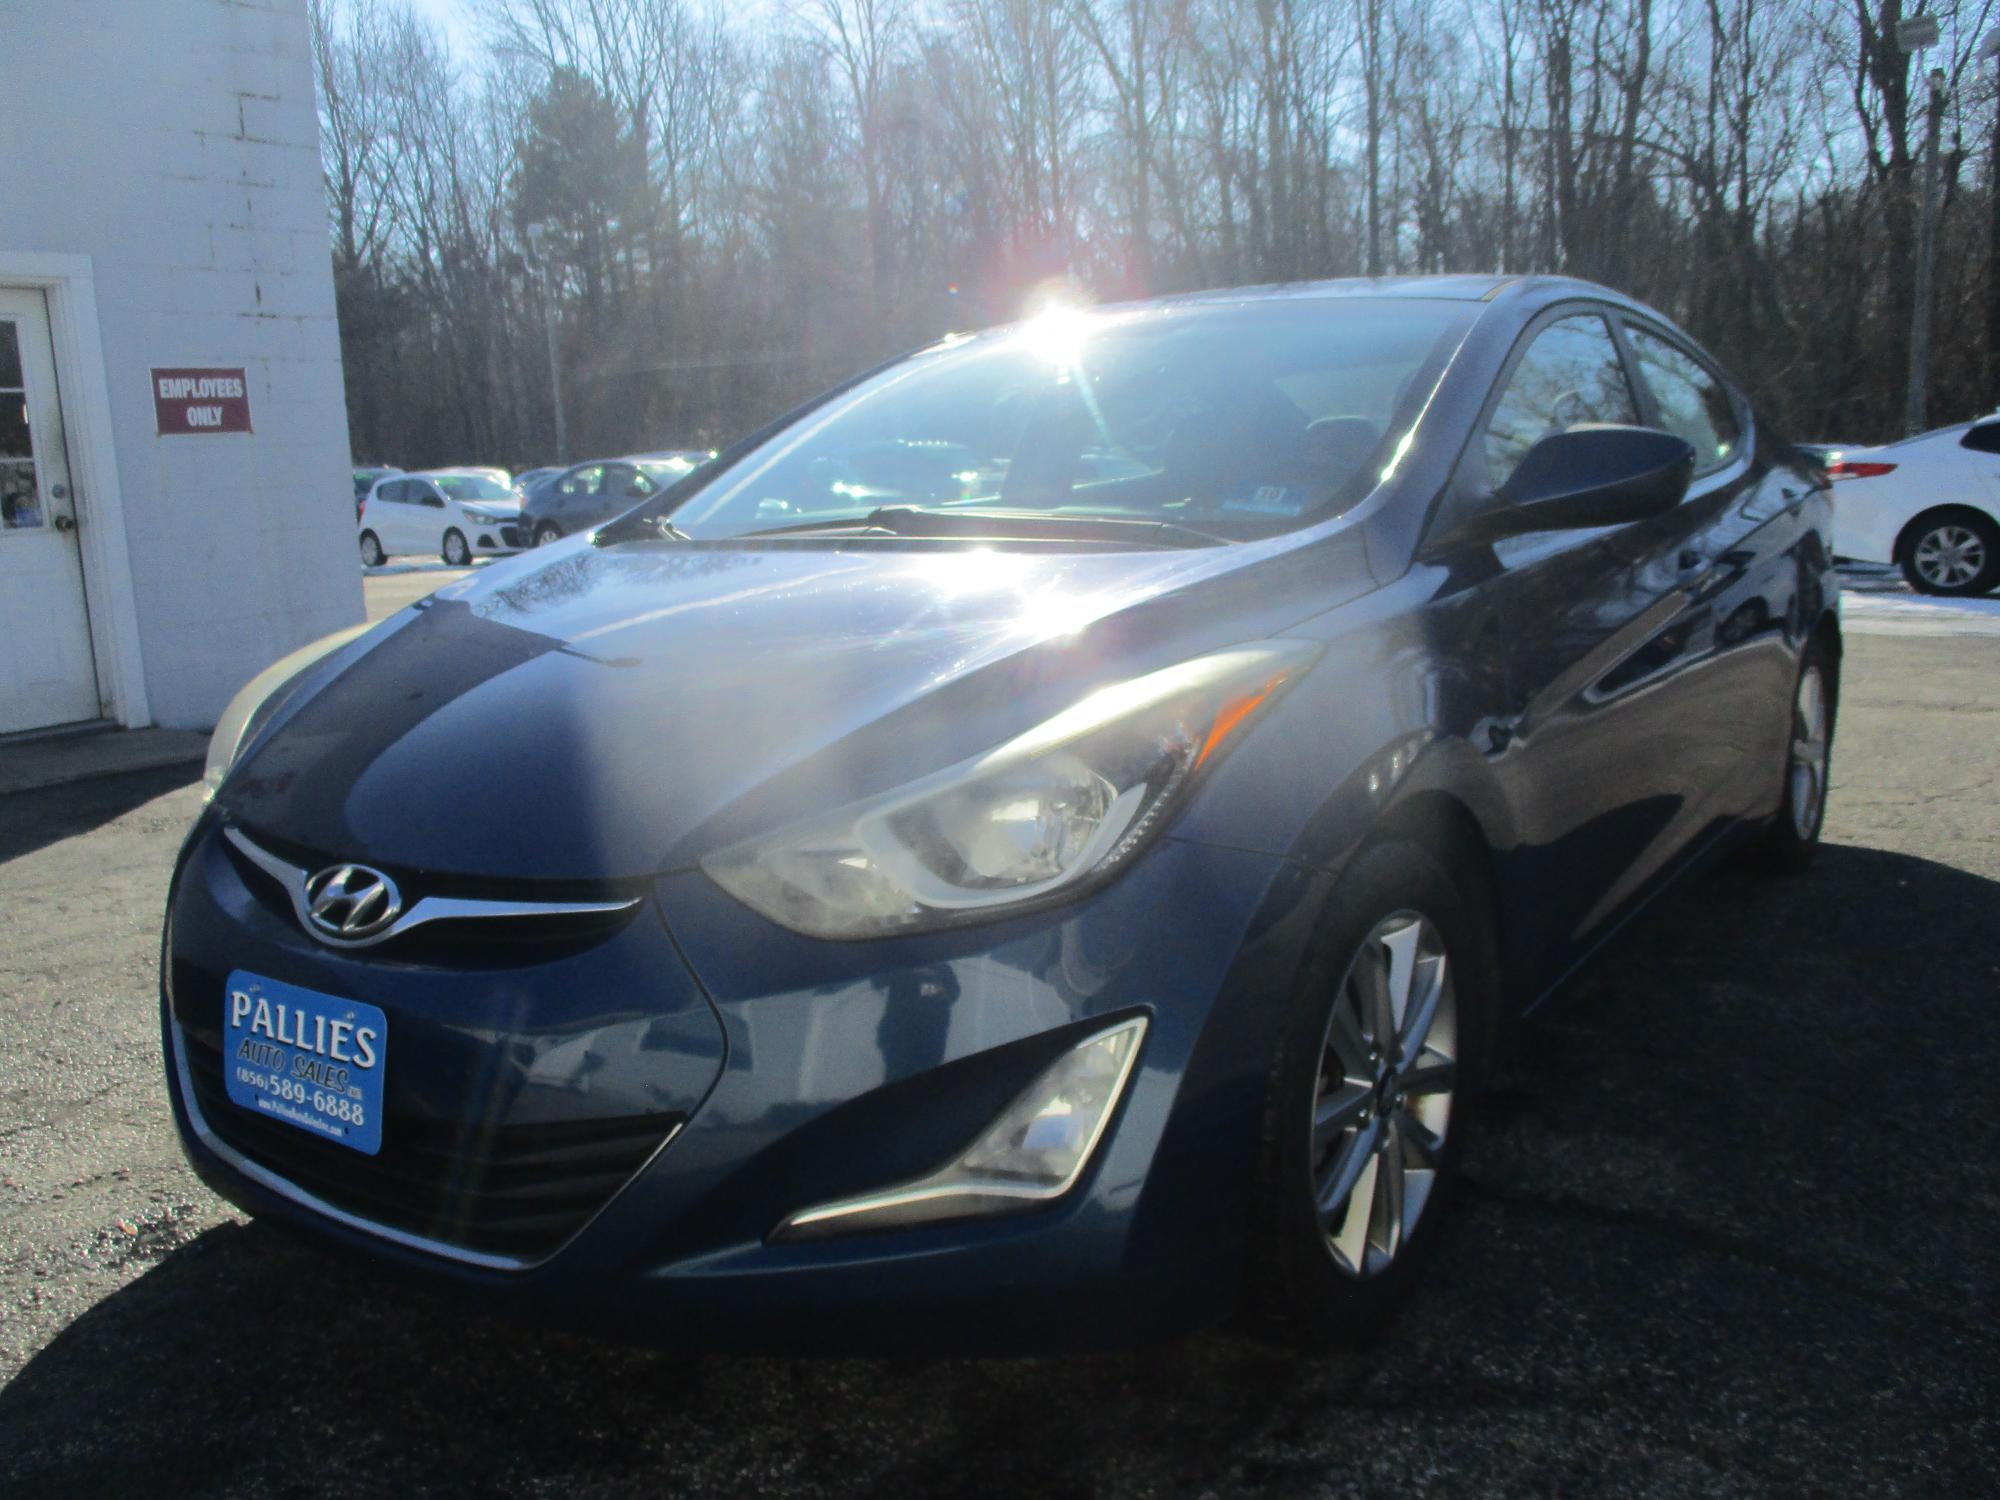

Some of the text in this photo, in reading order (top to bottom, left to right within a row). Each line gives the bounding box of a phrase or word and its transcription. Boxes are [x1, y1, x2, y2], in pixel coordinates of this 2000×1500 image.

[159, 378, 243, 399] EMPLOYEES
[187, 406, 222, 426] ONLY
[238, 1038, 286, 1072] AUTO
[291, 1054, 349, 1094] SALES
[270, 1074, 364, 1126] 589-6888
